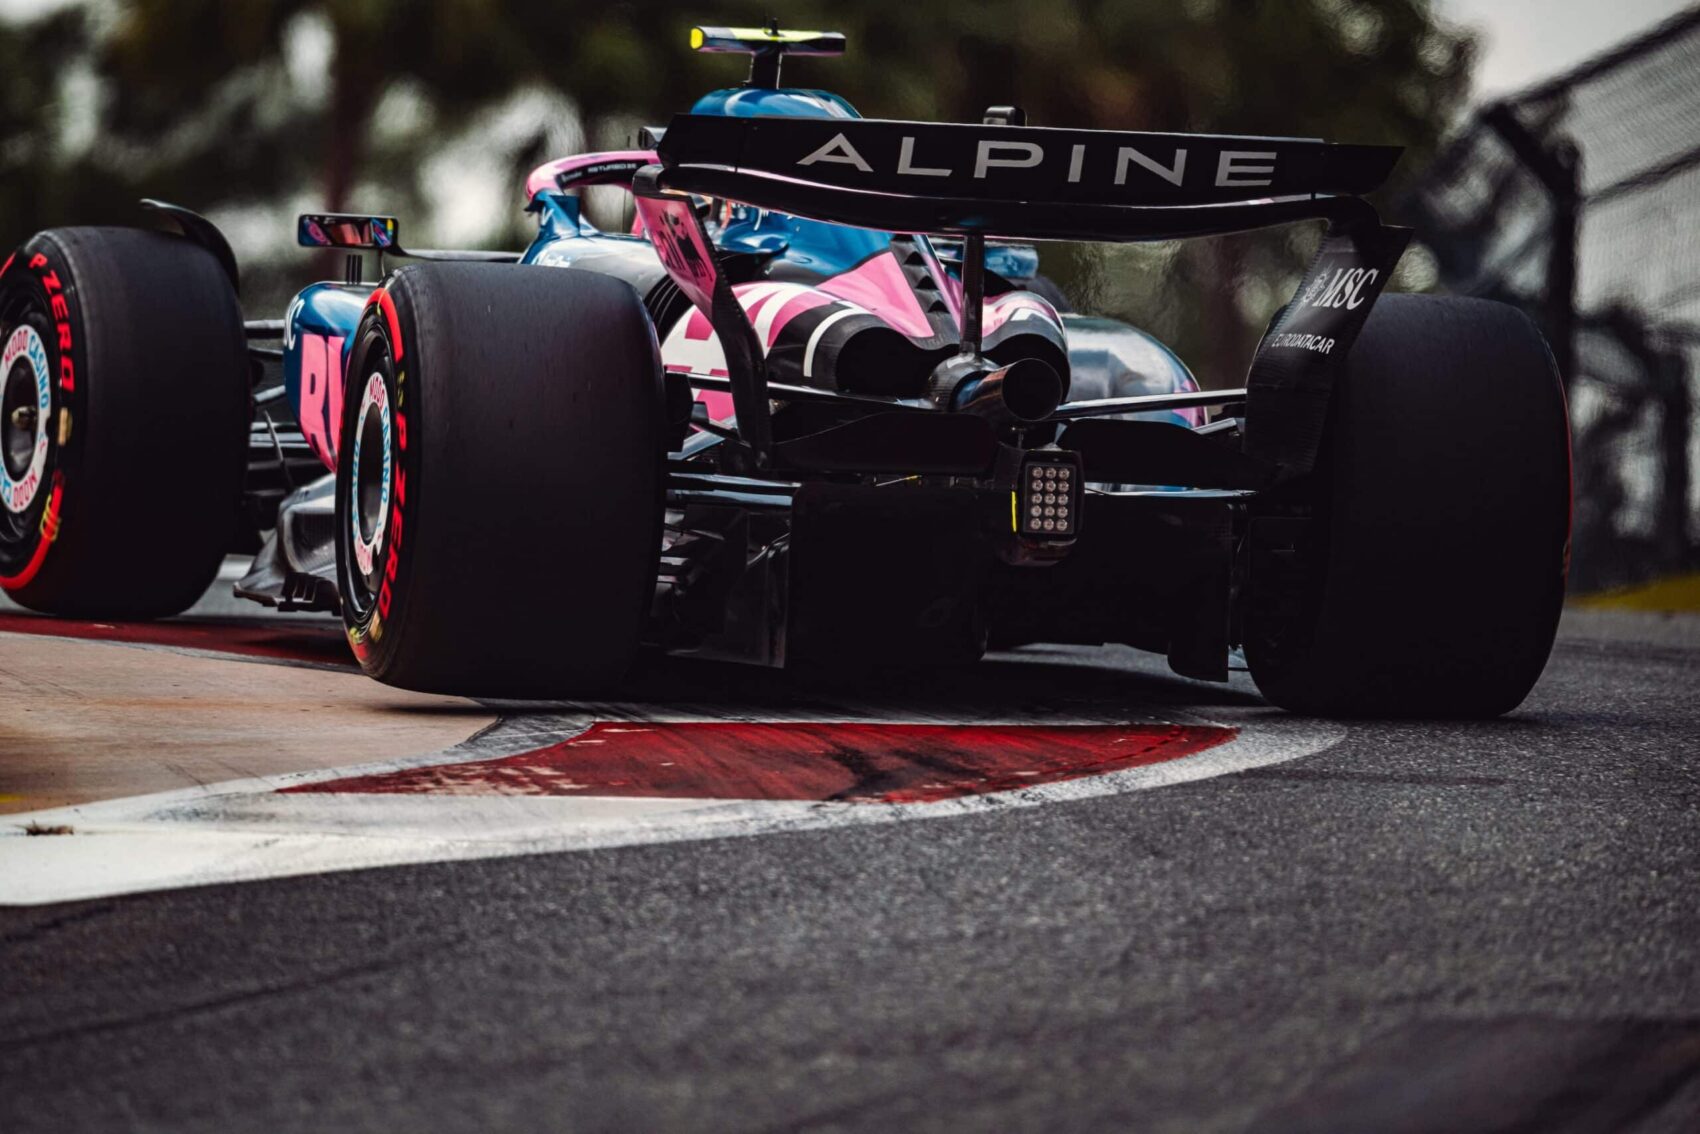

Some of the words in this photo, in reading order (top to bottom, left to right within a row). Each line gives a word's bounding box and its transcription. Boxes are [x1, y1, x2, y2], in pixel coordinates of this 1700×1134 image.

[796, 132, 1277, 188] ALPINE
[1312, 267, 1380, 310] MSC
[4, 329, 28, 368] MODO
[28, 335, 50, 410] CASINO
[42, 269, 75, 393] ZERO
[369, 376, 385, 411] MODO
[381, 409, 391, 505] CASINO
[395, 411, 408, 452] P
[379, 461, 407, 622] ZERO
